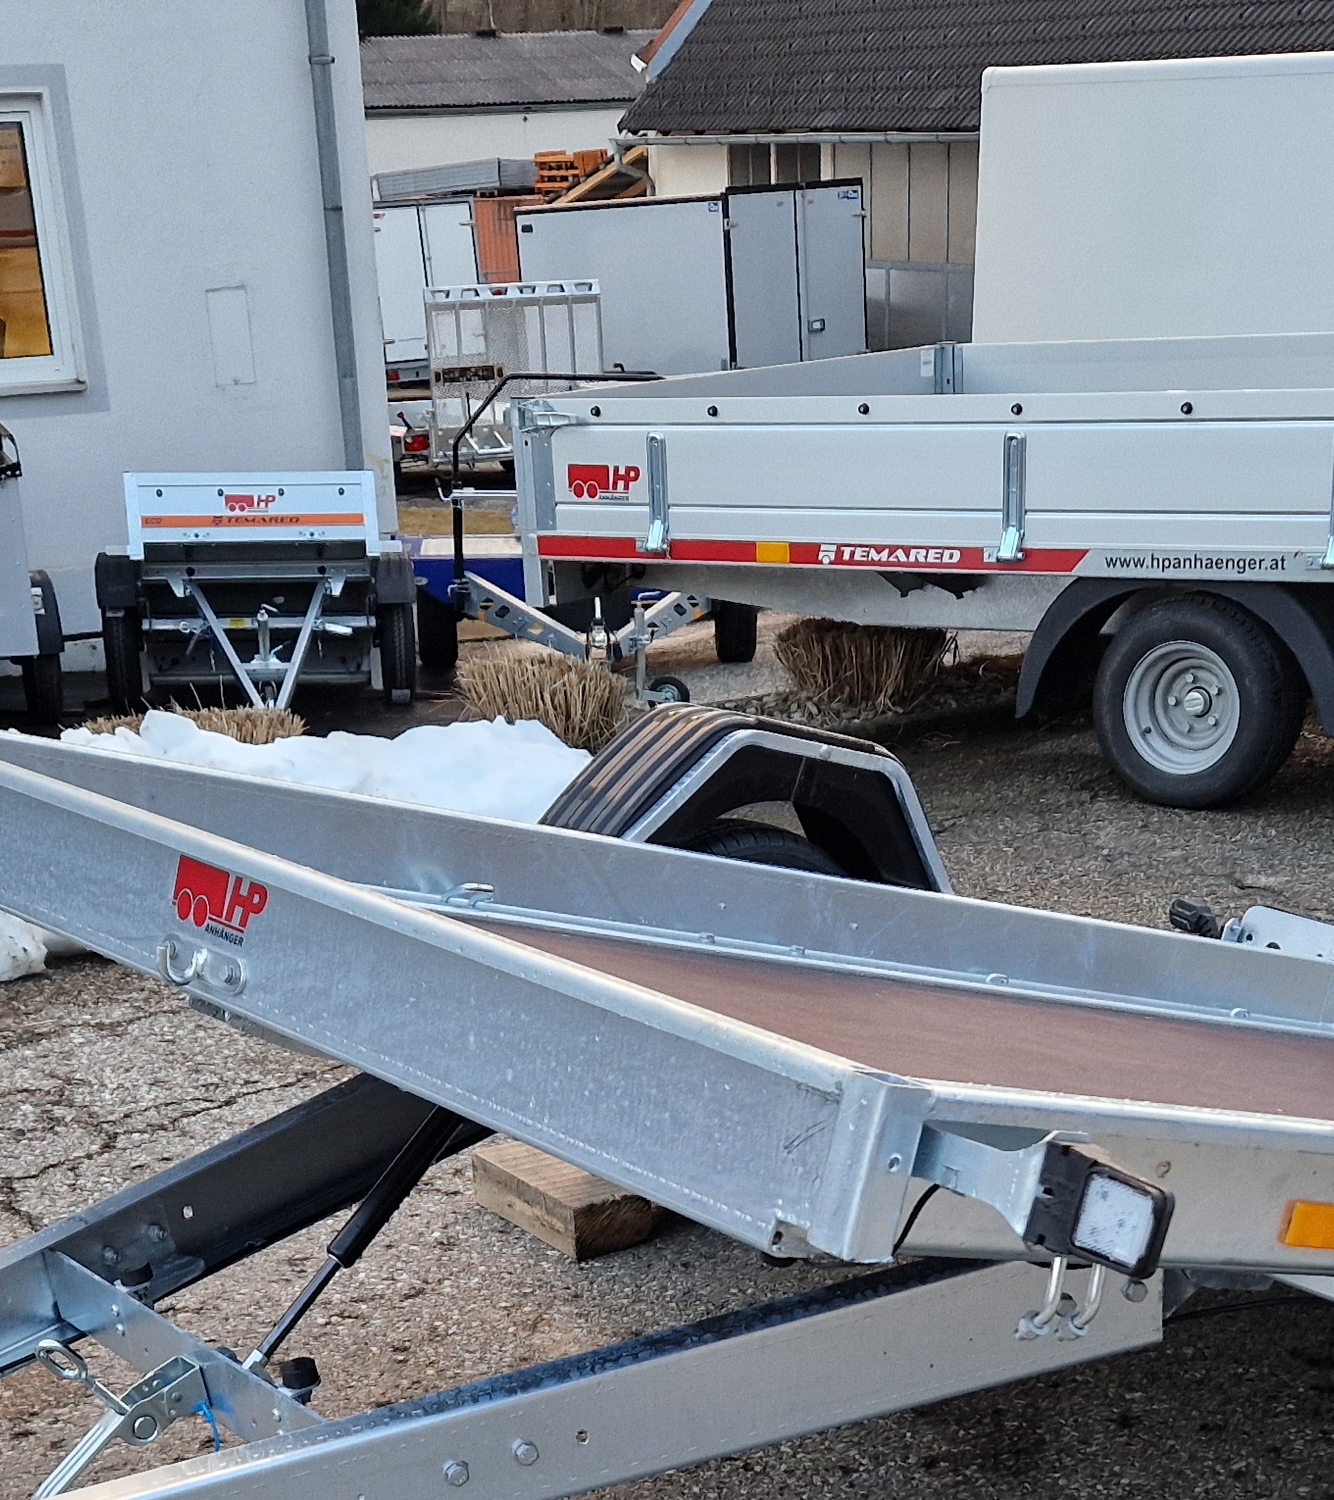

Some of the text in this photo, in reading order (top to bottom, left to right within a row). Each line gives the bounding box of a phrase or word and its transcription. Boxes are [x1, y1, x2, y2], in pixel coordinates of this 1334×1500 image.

[612, 465, 641, 491] HP
[256, 494, 276, 509] HP
[226, 515, 300, 524] TEMARED
[840, 546, 961, 564] TEMARED
[1104, 552, 1287, 575] www.hpanhaenger.at
[224, 875, 268, 928] HP
[204, 923, 245, 948] ANHÄNGER
